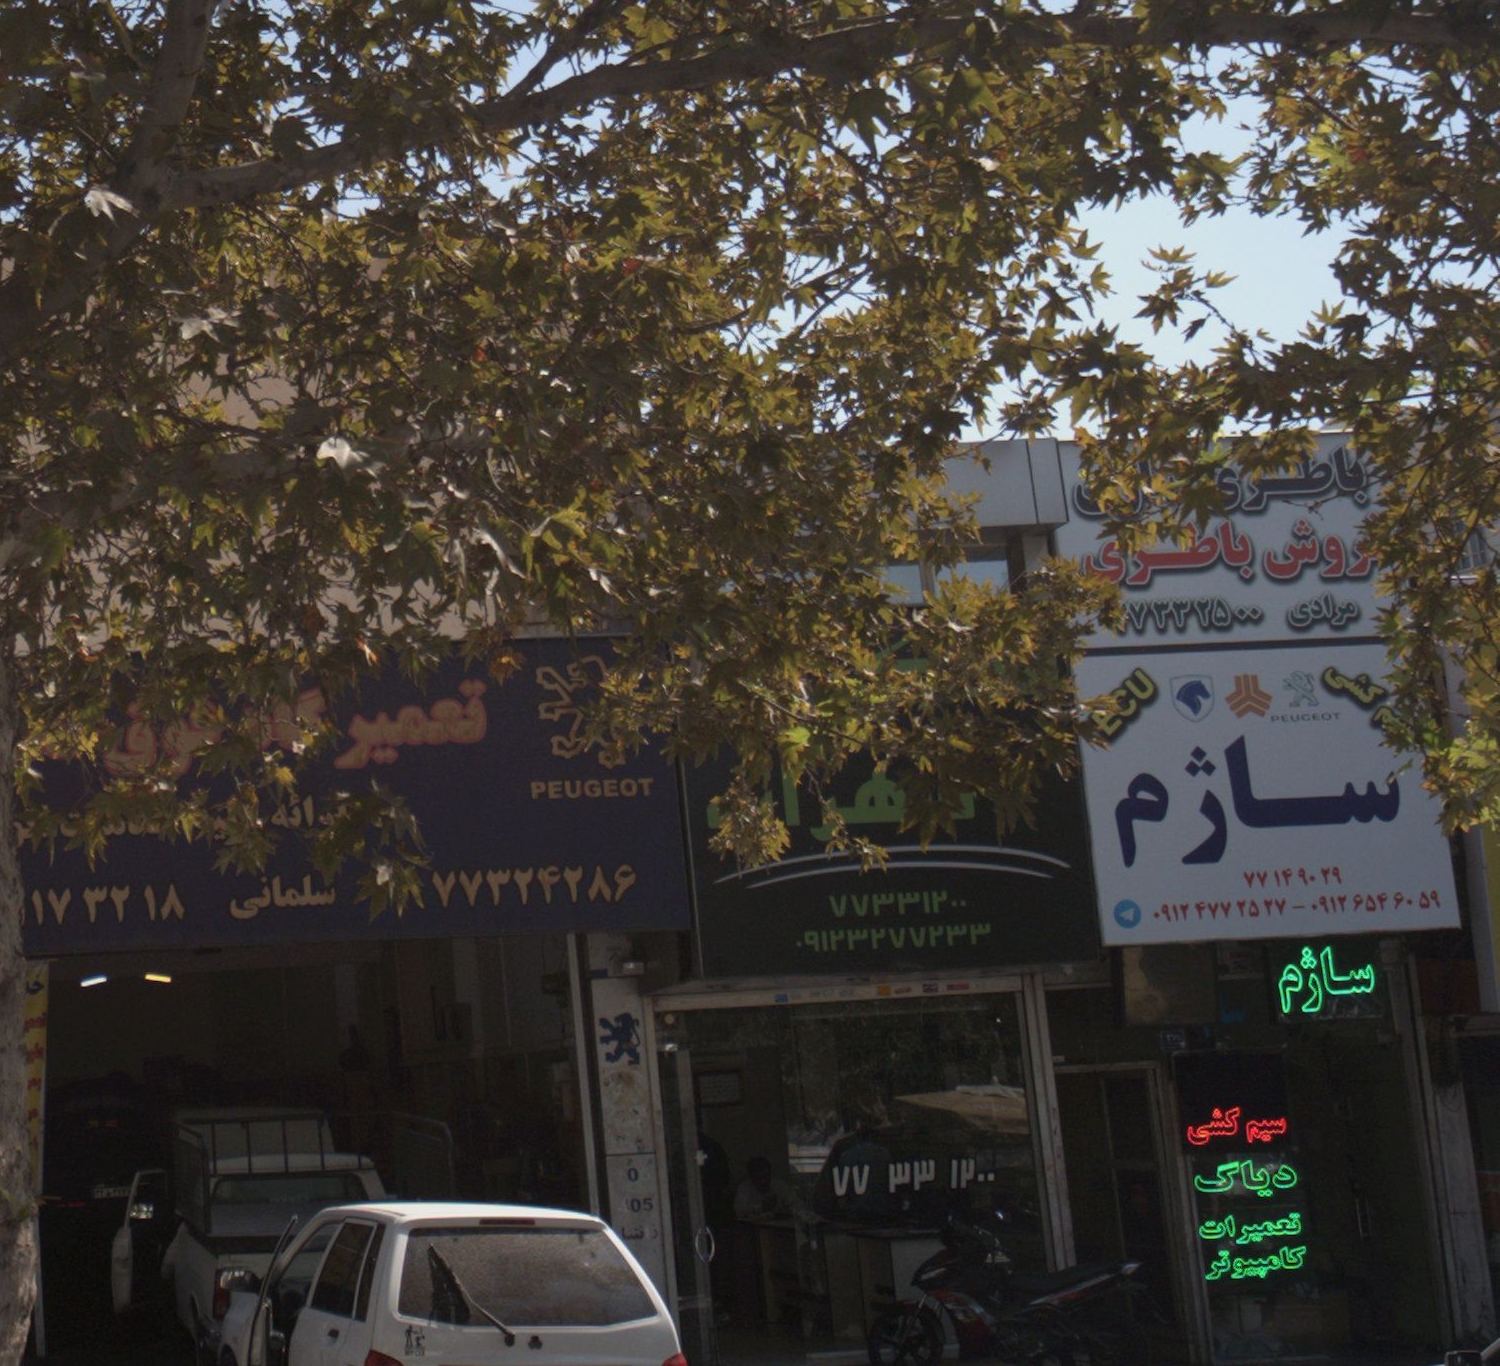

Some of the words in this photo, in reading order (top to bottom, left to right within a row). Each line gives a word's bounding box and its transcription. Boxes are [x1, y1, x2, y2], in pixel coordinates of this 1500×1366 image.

[1288, 590, 1358, 628] مرادی
[1270, 711, 1341, 723] PEUGEOT
[530, 777, 654, 801] PEUGEOT
[1114, 735, 1400, 869] ساژم
[229, 876, 337, 921] سلمانی
[430, 863, 638, 909] ۷۷۳۲۴۲۸۶
[828, 890, 967, 918] ۷۷۳۳۱۲۰۰
[1278, 945, 1377, 1015] ساژم
[1186, 1106, 1241, 1146] کشی
[1245, 1116, 1288, 1144] سیم
[1199, 1211, 1303, 1245] تعمیرات
[1204, 1245, 1308, 1281] کامپیوتر
